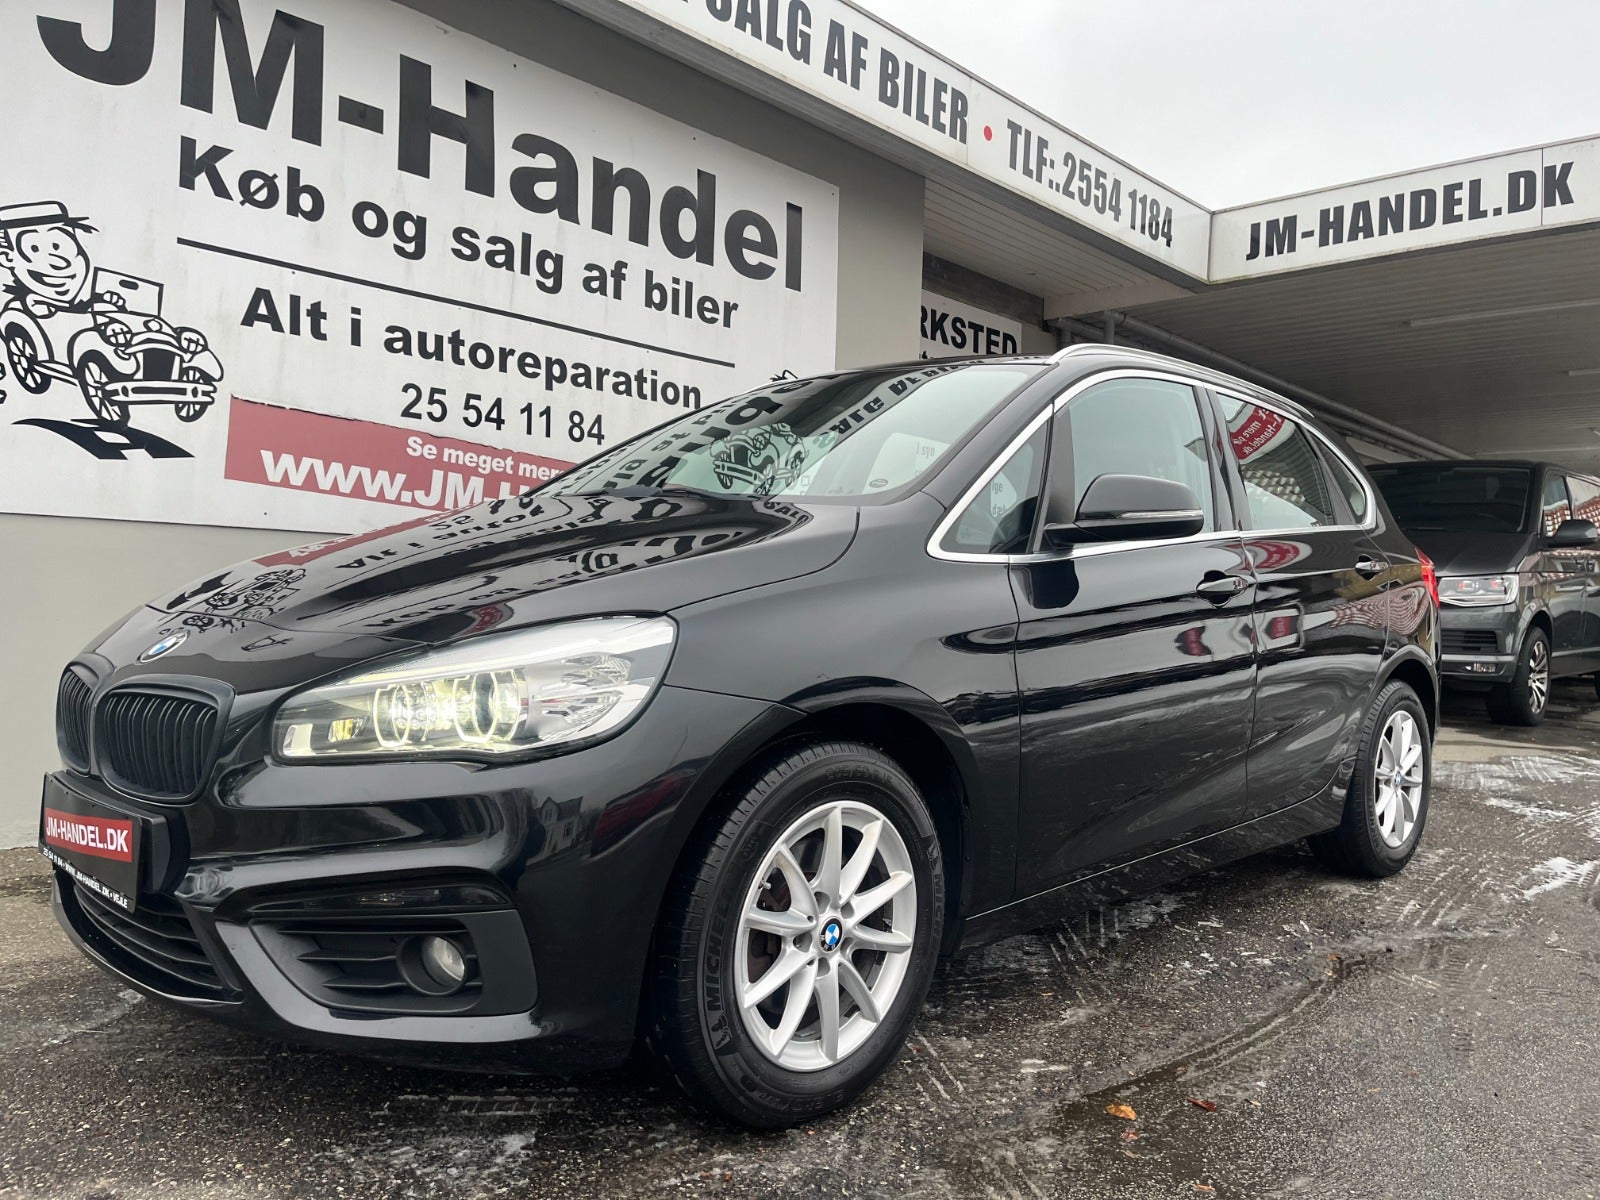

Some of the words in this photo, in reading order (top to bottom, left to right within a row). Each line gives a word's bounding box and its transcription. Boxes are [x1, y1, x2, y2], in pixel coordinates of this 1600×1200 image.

[36, 0, 803, 292] JM-Handel
[824, 18, 868, 91] AF
[878, 47, 968, 145] BILER
[1128, 187, 1173, 247] 1184
[179, 135, 325, 222] Køb
[351, 200, 427, 260] og
[451, 225, 564, 295] salg
[582, 260, 629, 300] af
[644, 269, 738, 328] biler
[1246, 161, 1574, 261] JM-HANDEL.DK
[240, 287, 328, 341] Alt
[350, 306, 362, 347] i
[383, 325, 701, 410] autoreparation
[400, 383, 448, 423] 25
[462, 393, 505, 431] 54
[520, 404, 552, 438] 11
[567, 410, 605, 445] 84
[406, 436, 438, 460] Se
[443, 447, 514, 475] meget
[260, 449, 530, 512] www.JM-H
[45, 816, 129, 852] JM-HANDEL.DK
